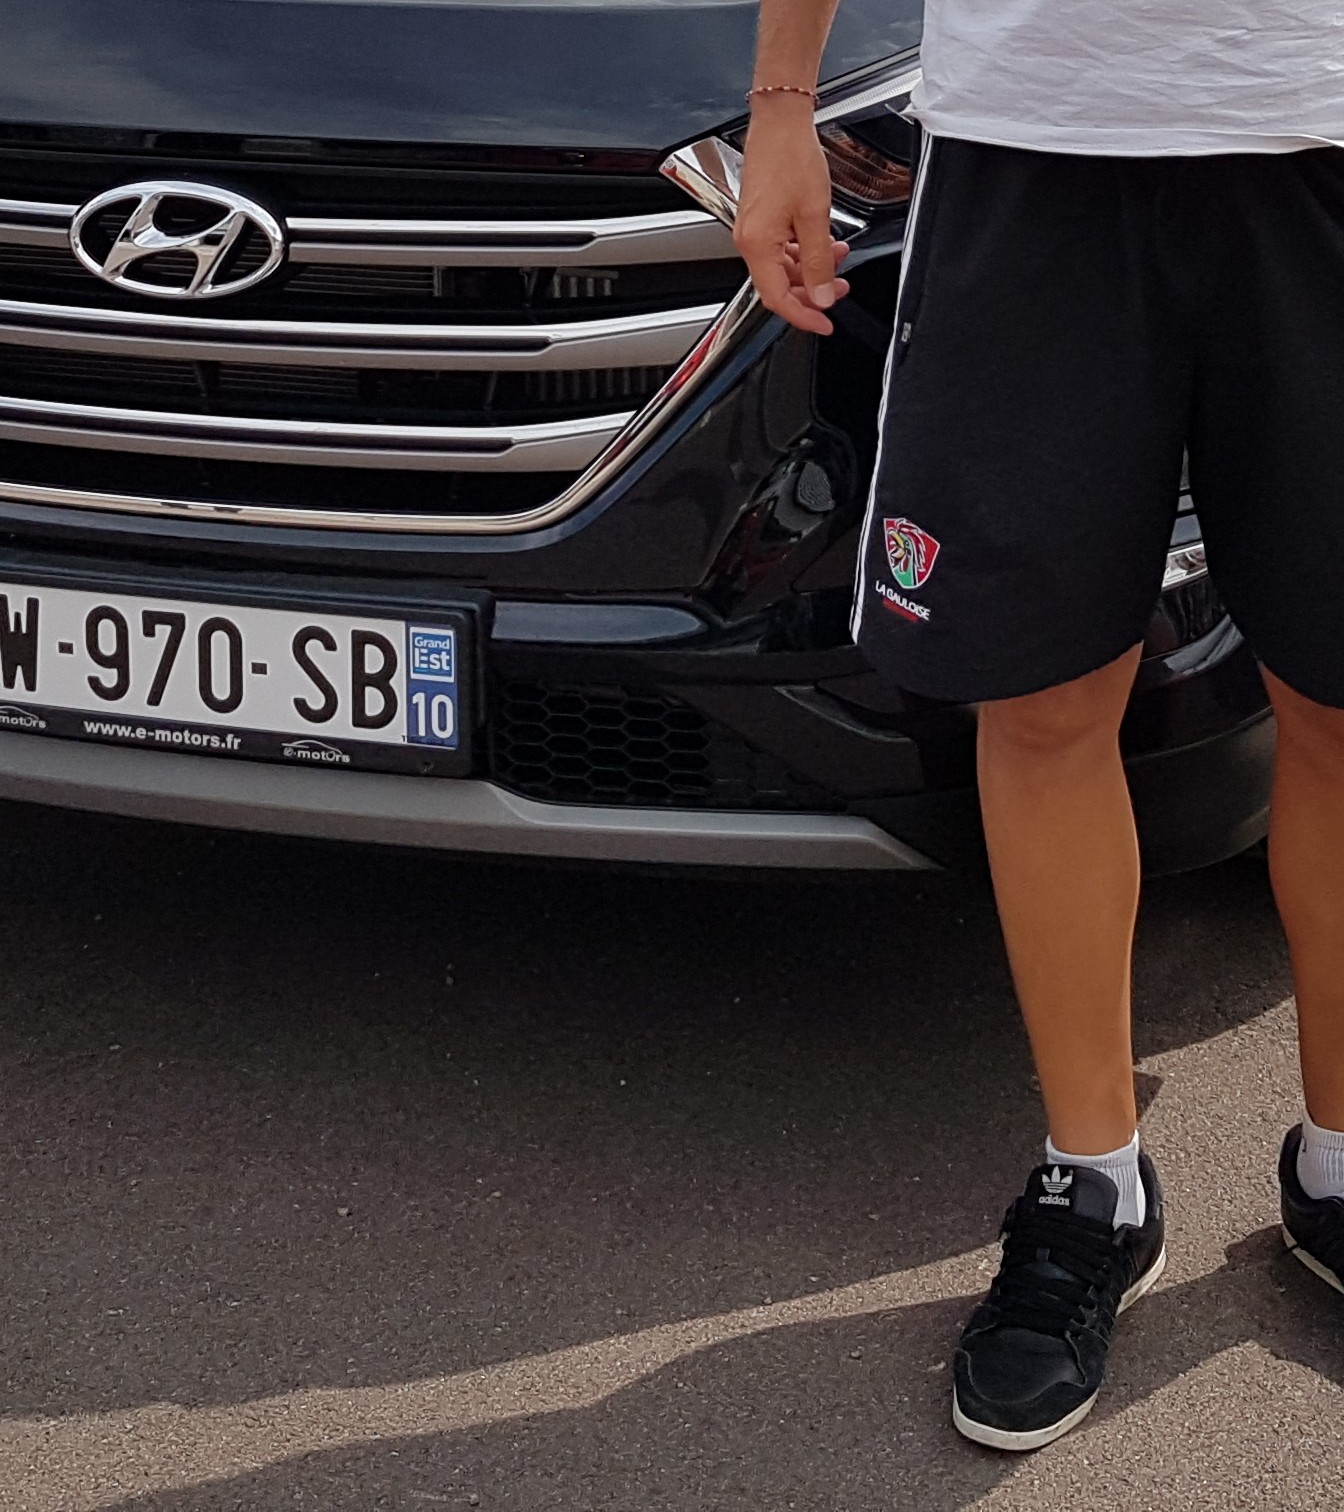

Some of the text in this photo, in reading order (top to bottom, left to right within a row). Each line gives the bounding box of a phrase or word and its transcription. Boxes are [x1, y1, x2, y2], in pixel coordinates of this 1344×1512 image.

[875, 579, 886, 597] LA
[886, 590, 932, 622] GAULOISE
[414, 636, 450, 651] Grand
[414, 648, 451, 672] Est
[412, 691, 454, 739] 10
[83, 719, 242, 750] www.e-motors.fr
[1038, 1194, 1071, 1207] adidas
